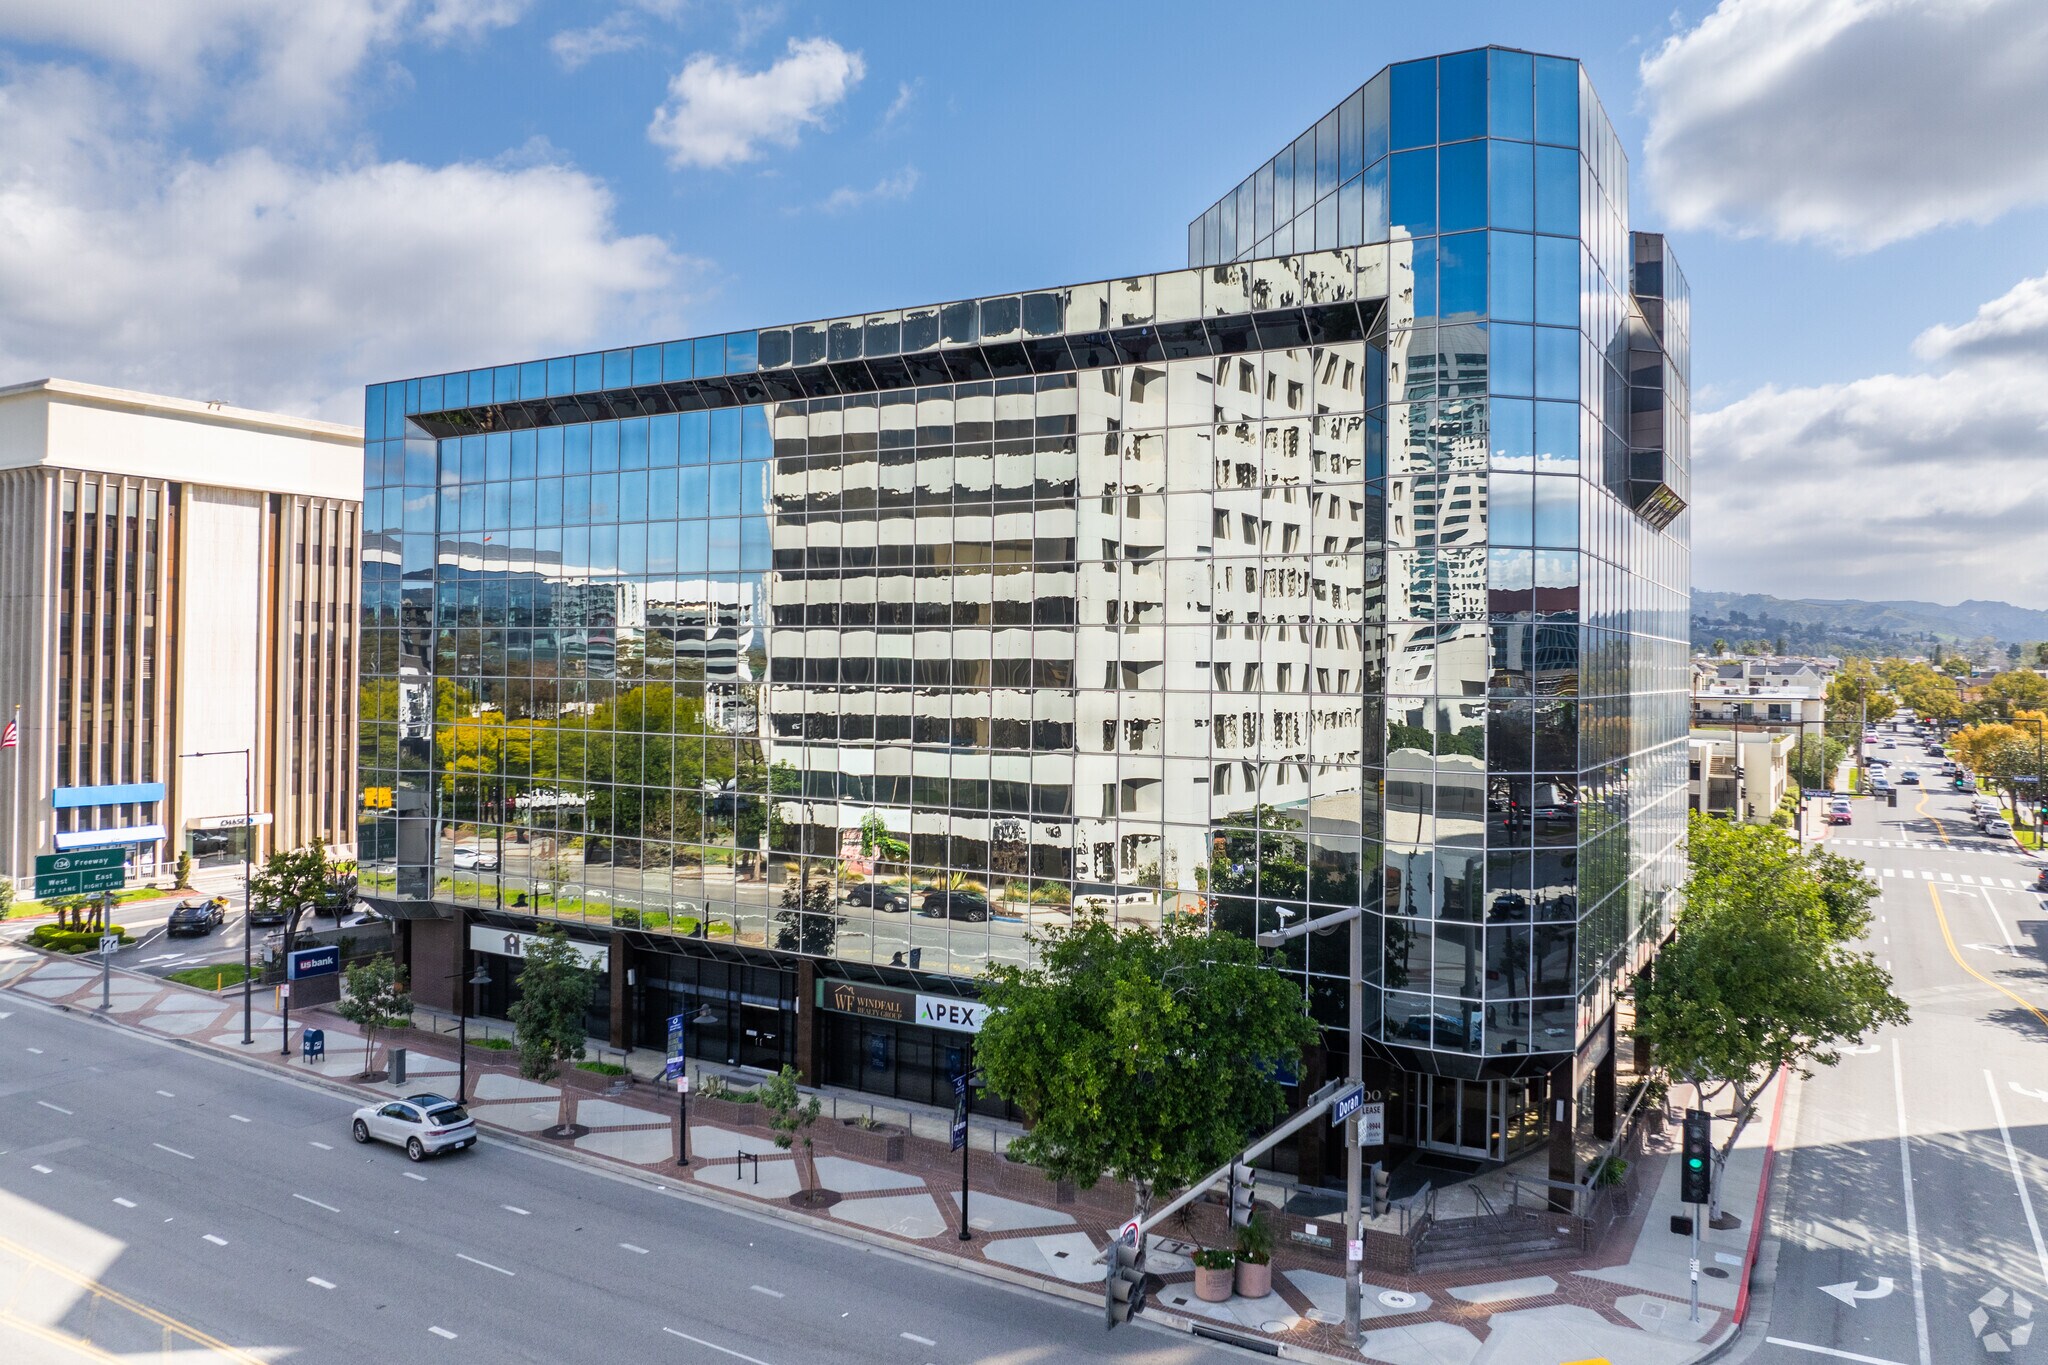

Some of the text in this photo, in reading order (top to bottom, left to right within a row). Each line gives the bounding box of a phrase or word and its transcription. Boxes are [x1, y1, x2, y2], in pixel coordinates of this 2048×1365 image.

[220, 818, 246, 827] CHASE
[56, 857, 109, 868] 134 Freeway
[48, 878, 68, 887] West
[95, 873, 113, 881] East
[39, 885, 77, 896] LEFT LANE
[83, 880, 123, 890] RIGHT LANE
[857, 997, 902, 1013] WINDFALL
[857, 1007, 902, 1020] REALTY GROUP
[921, 1002, 975, 1027] APEX
[1339, 1095, 1359, 1118] Doran
[1362, 1106, 1381, 1115] LEASE
